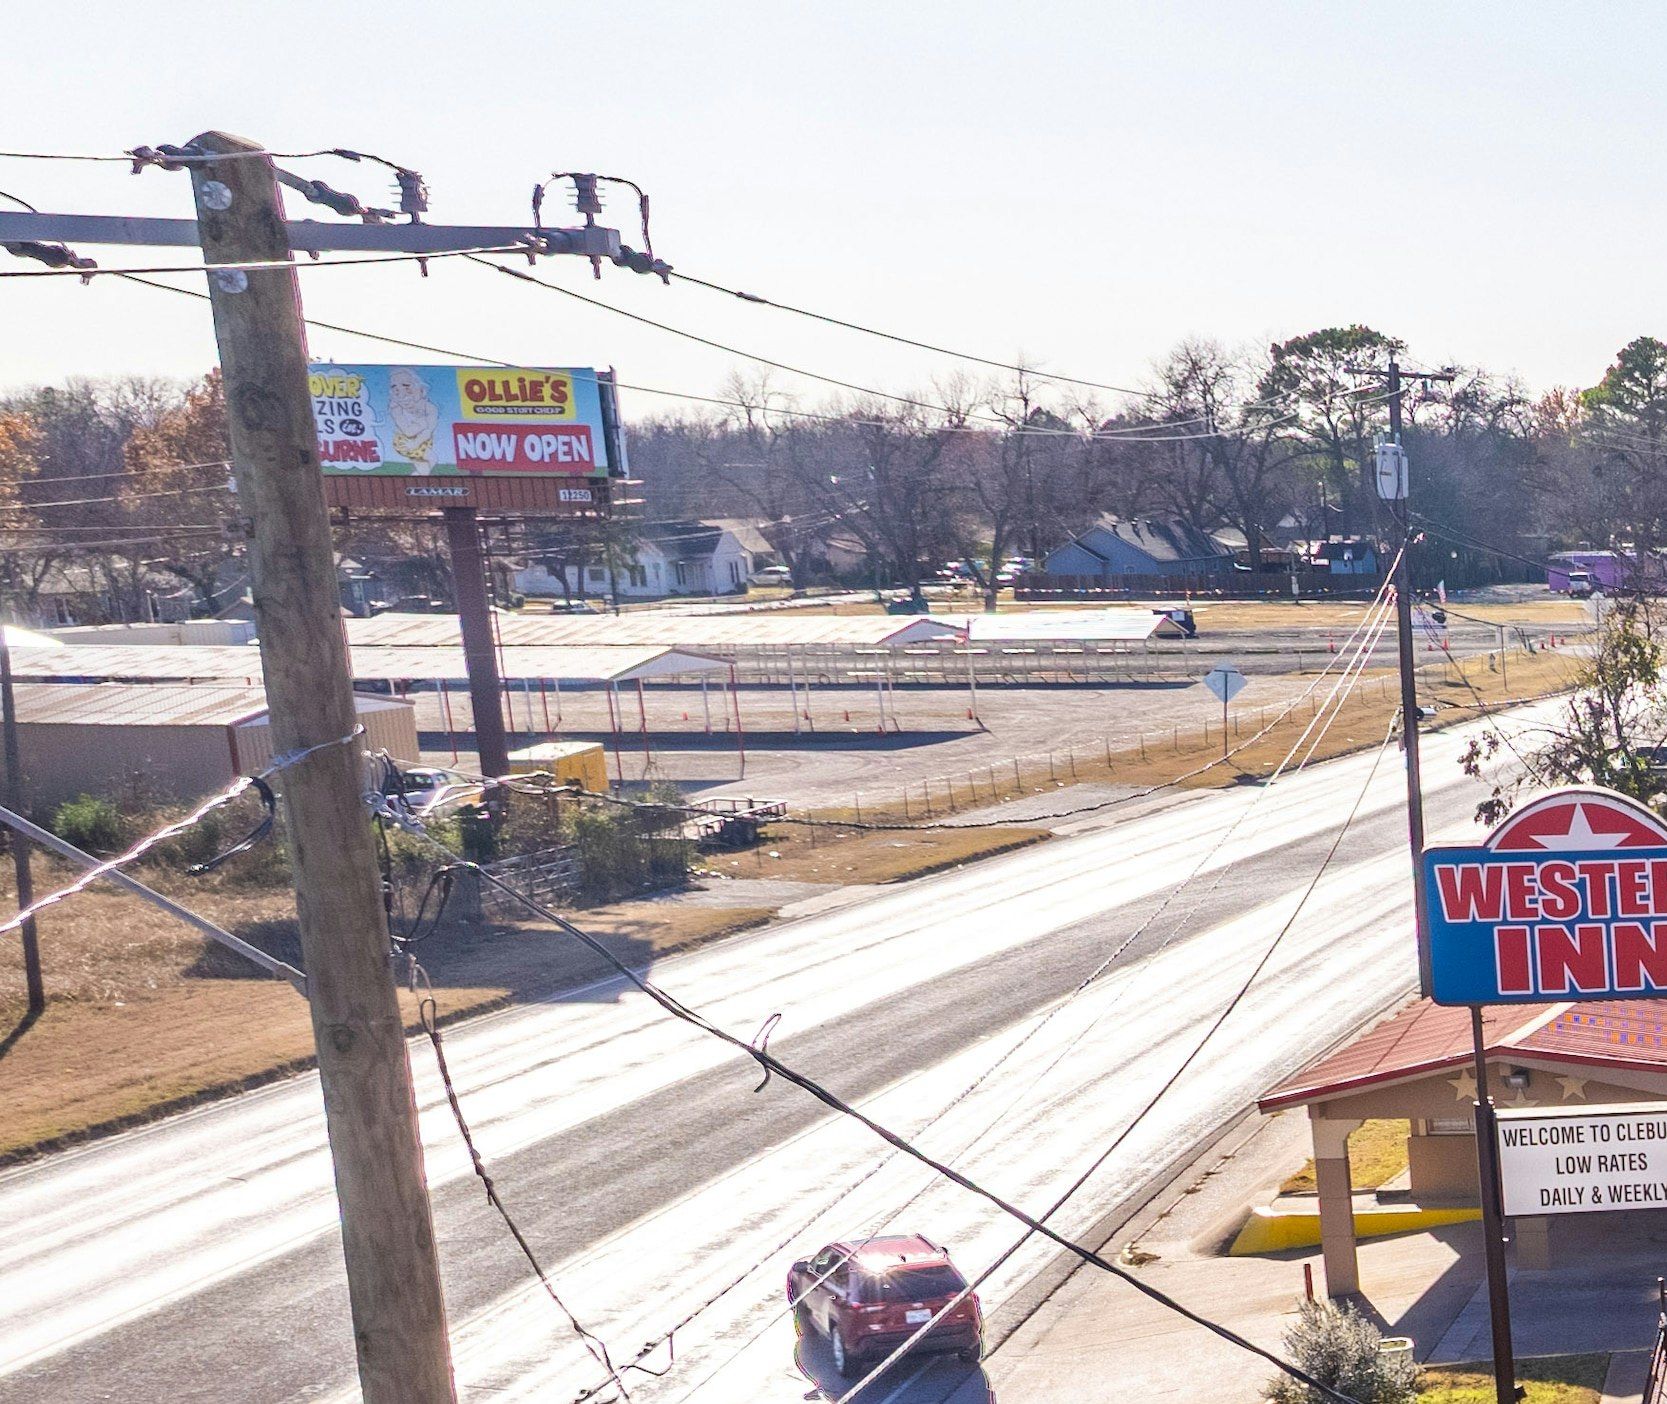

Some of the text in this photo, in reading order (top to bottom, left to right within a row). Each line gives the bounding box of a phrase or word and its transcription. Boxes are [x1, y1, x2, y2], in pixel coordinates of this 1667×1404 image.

[457, 432, 591, 463] NOW OPEN
[410, 487, 464, 496] LAMAR
[1503, 1125, 1585, 1147] WELCOME
[1590, 1124, 1611, 1143] TO
[1556, 1152, 1648, 1175] LOW RATES
[1540, 1186, 1585, 1207] DAILY
[1591, 1186, 1602, 1204] &
